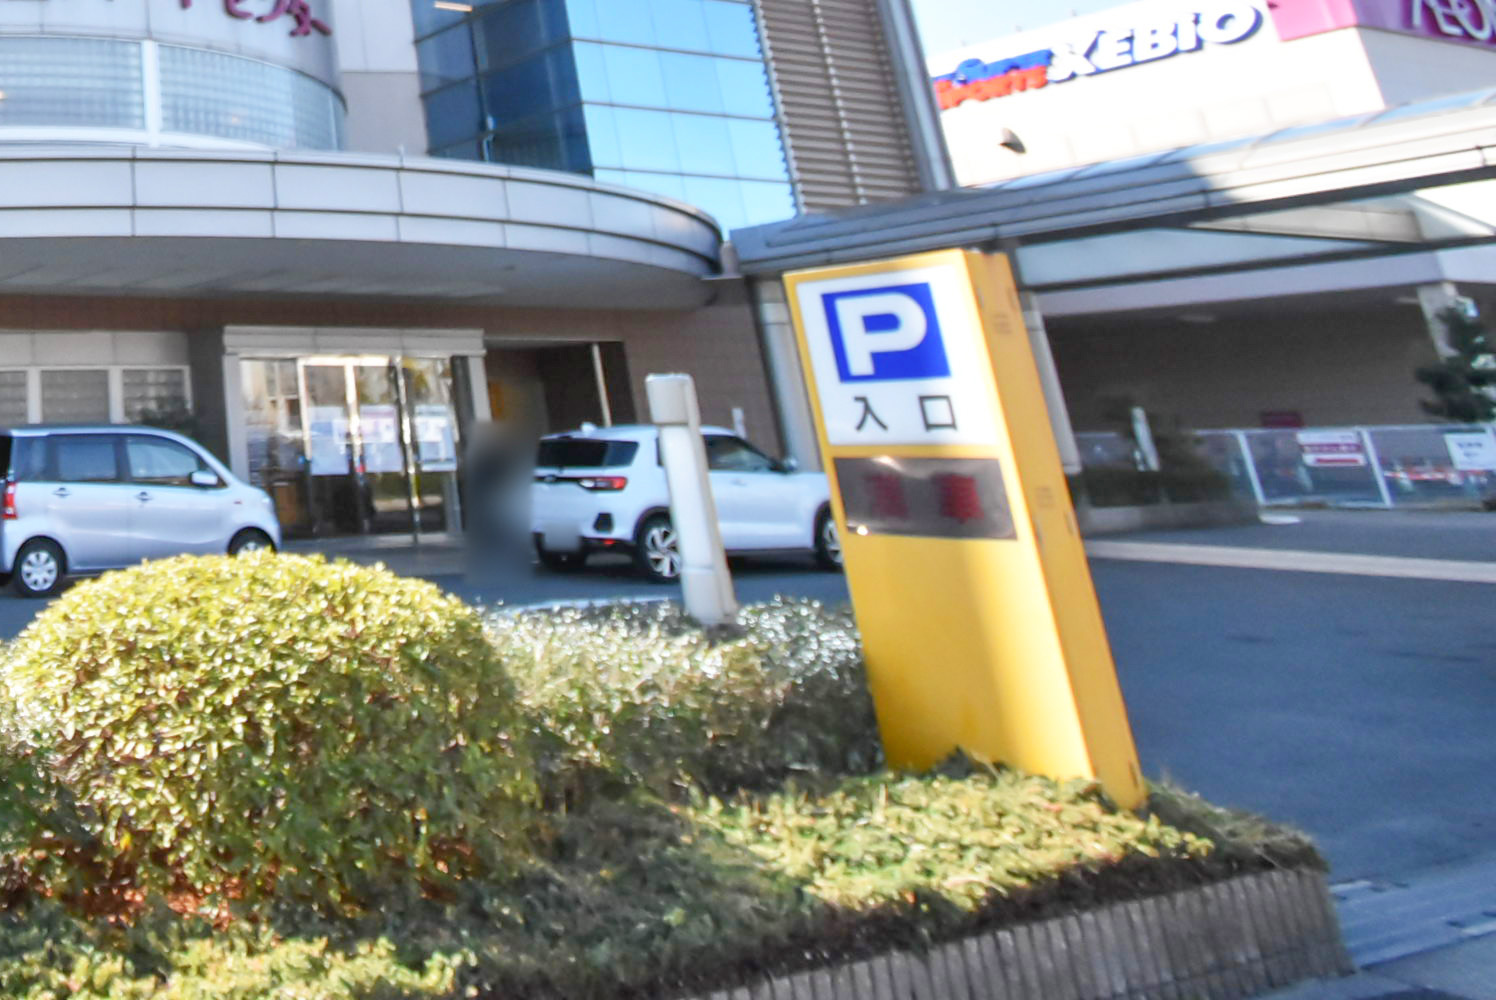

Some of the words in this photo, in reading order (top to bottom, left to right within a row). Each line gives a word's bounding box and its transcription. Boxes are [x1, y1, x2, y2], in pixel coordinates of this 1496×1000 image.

[1047, 5, 1264, 84] XEBIO
[834, 291, 928, 376] P
[852, 394, 958, 433] 入口
